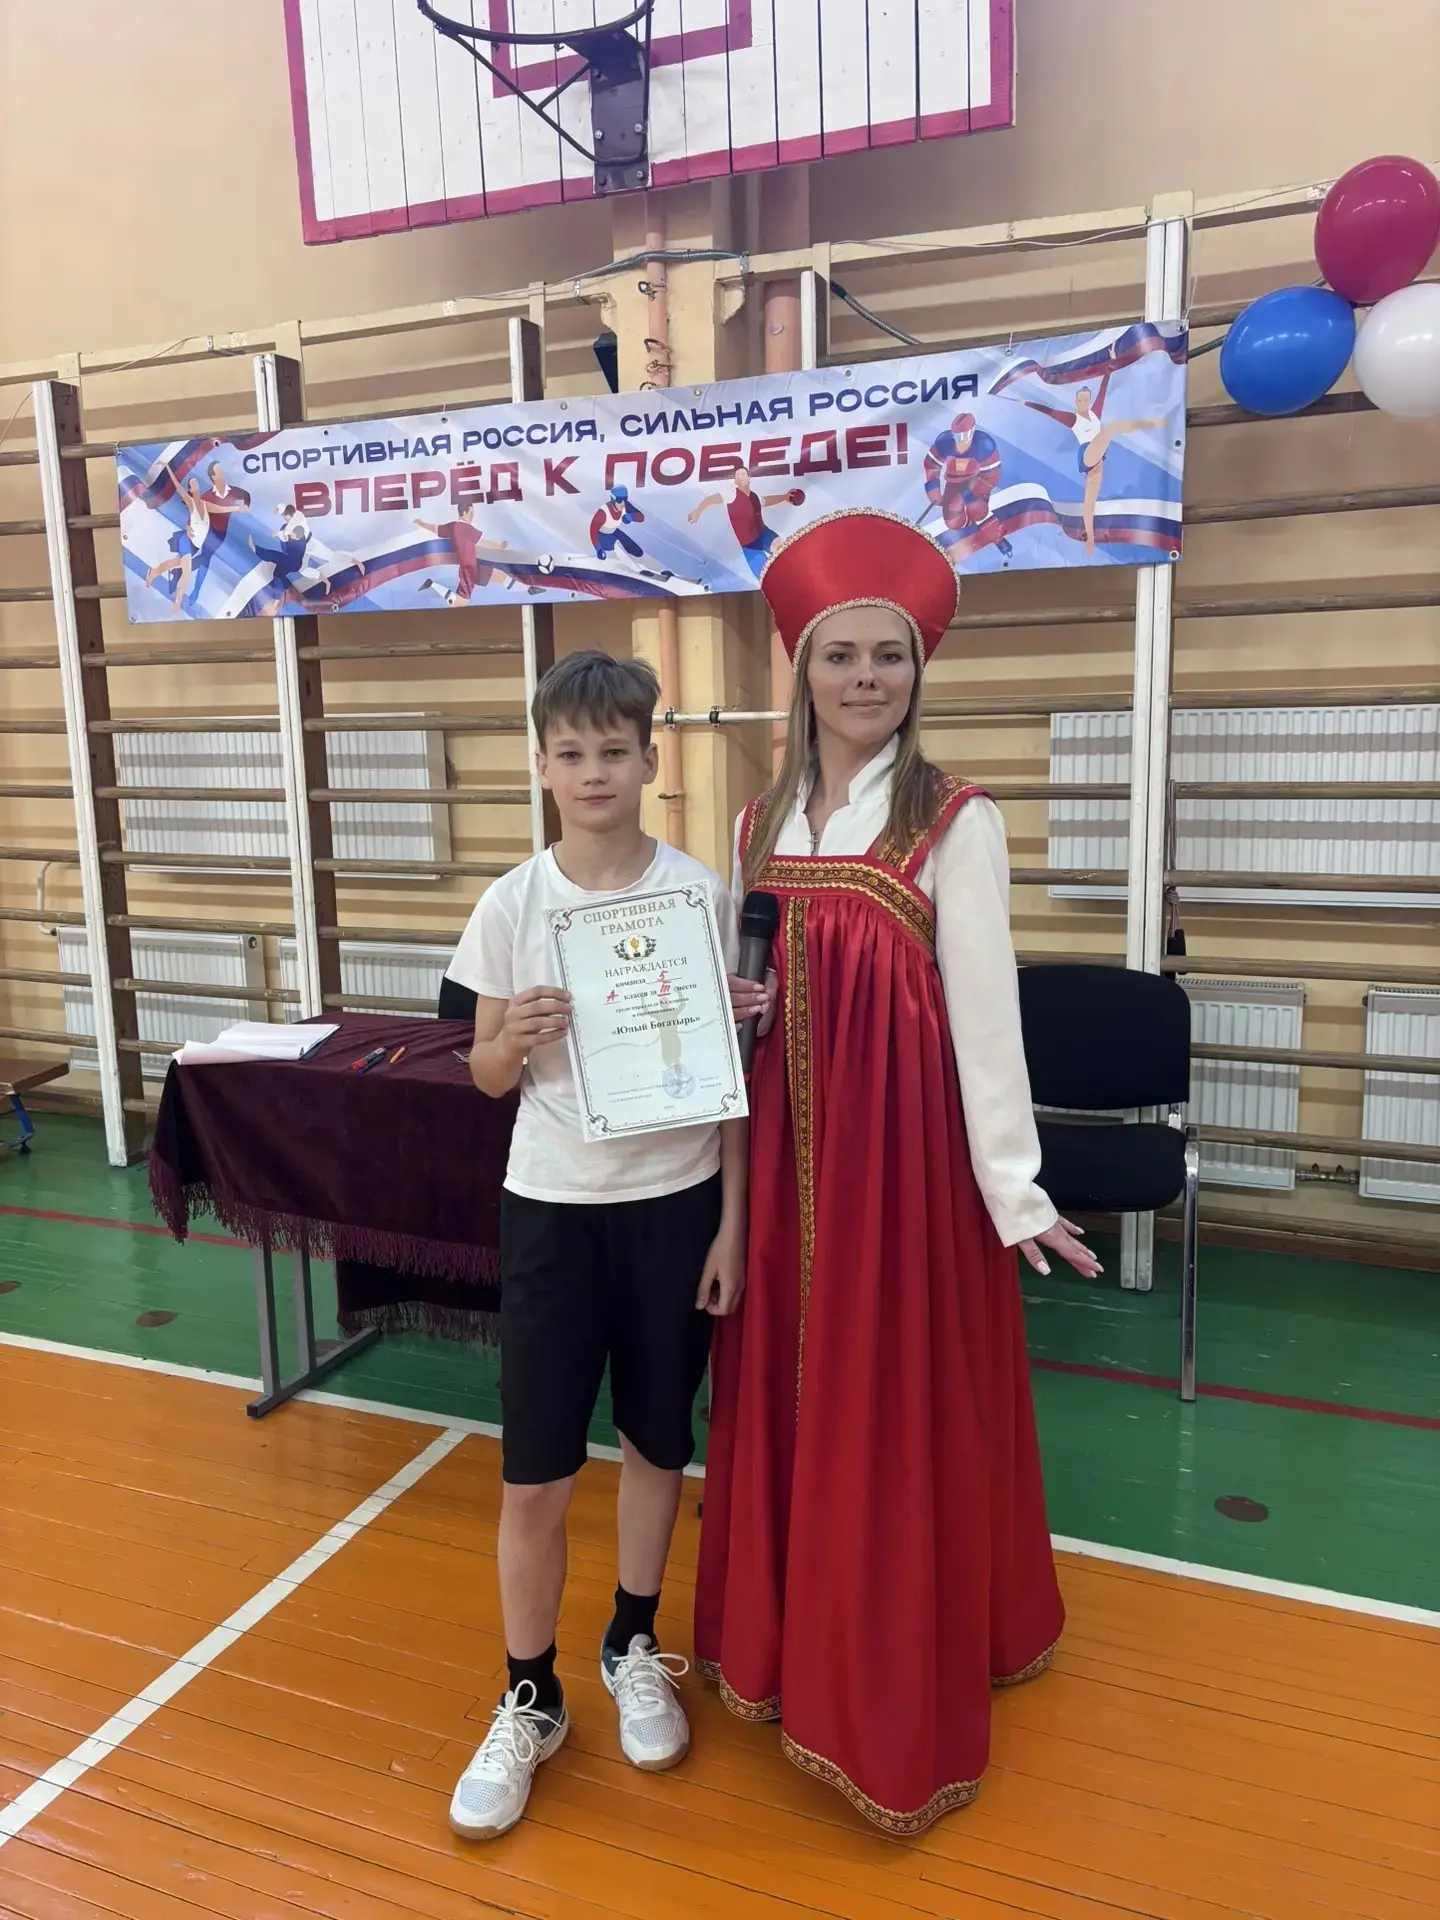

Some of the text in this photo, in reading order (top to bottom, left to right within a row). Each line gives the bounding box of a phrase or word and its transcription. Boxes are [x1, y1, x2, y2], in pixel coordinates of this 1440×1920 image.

[242, 373, 980, 475] СПОРТИВНАЯ РОССИЯ, СИЛЬНАЯ РОССИЯ
[293, 421, 909, 519] ВПЕРЁД К ПОБЕДЕ!
[583, 899, 676, 924] СПОРТИВНАЯ
[600, 916, 665, 936] ГРАМОТА
[605, 957, 688, 978] НАГРАЖДАЕТСЯ
[615, 978, 646, 988] команда
[623, 990, 648, 1000] класса
